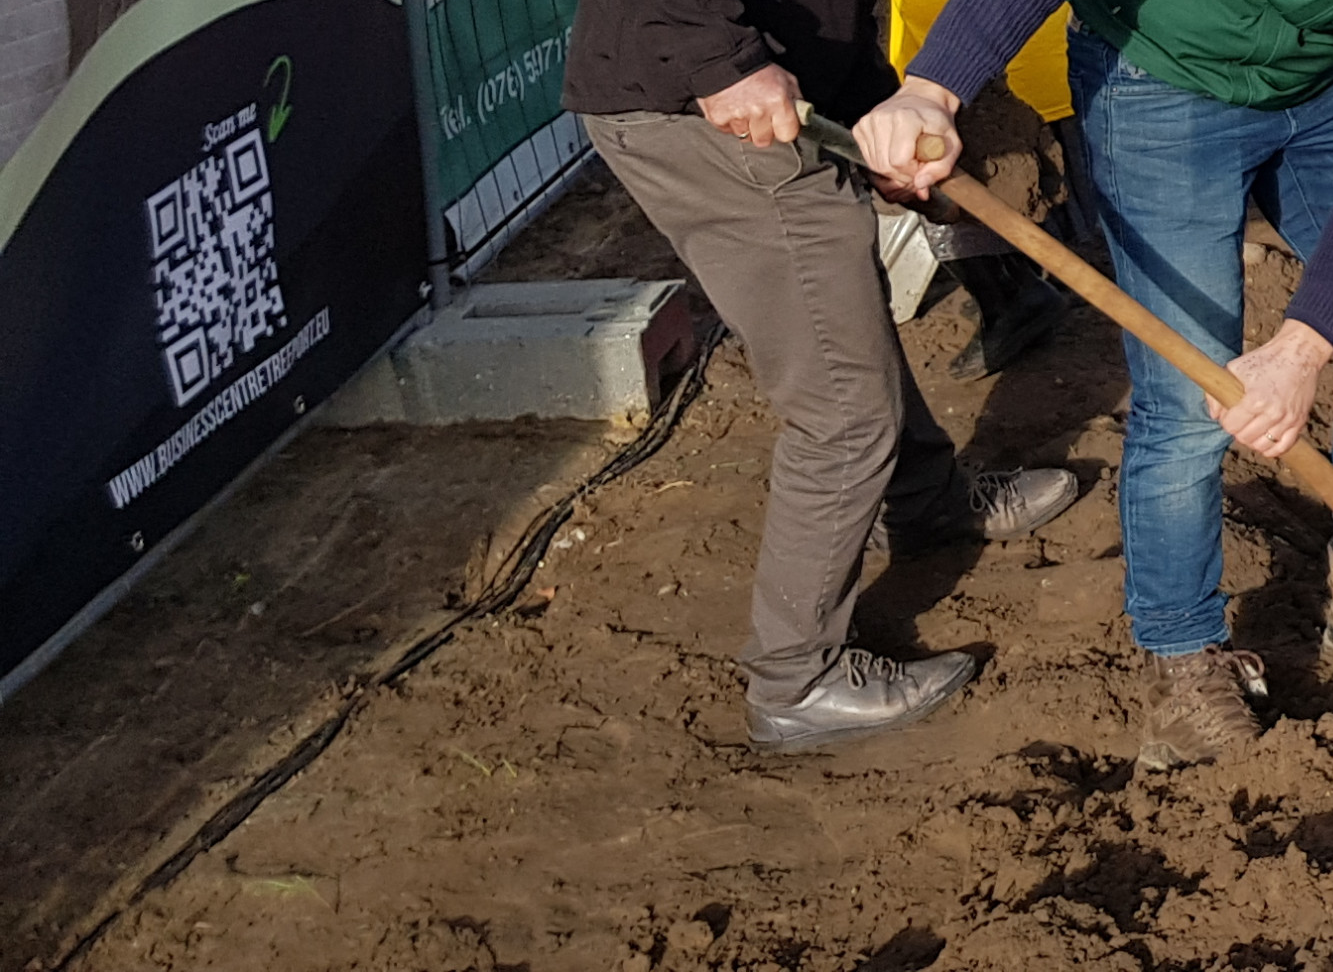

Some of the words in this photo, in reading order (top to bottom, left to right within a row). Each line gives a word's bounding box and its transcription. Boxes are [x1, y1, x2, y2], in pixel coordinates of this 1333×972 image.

[202, 117, 236, 153] Scan
[237, 102, 258, 129] me
[440, 94, 472, 141] Tel.
[477, 60, 525, 125] (076)
